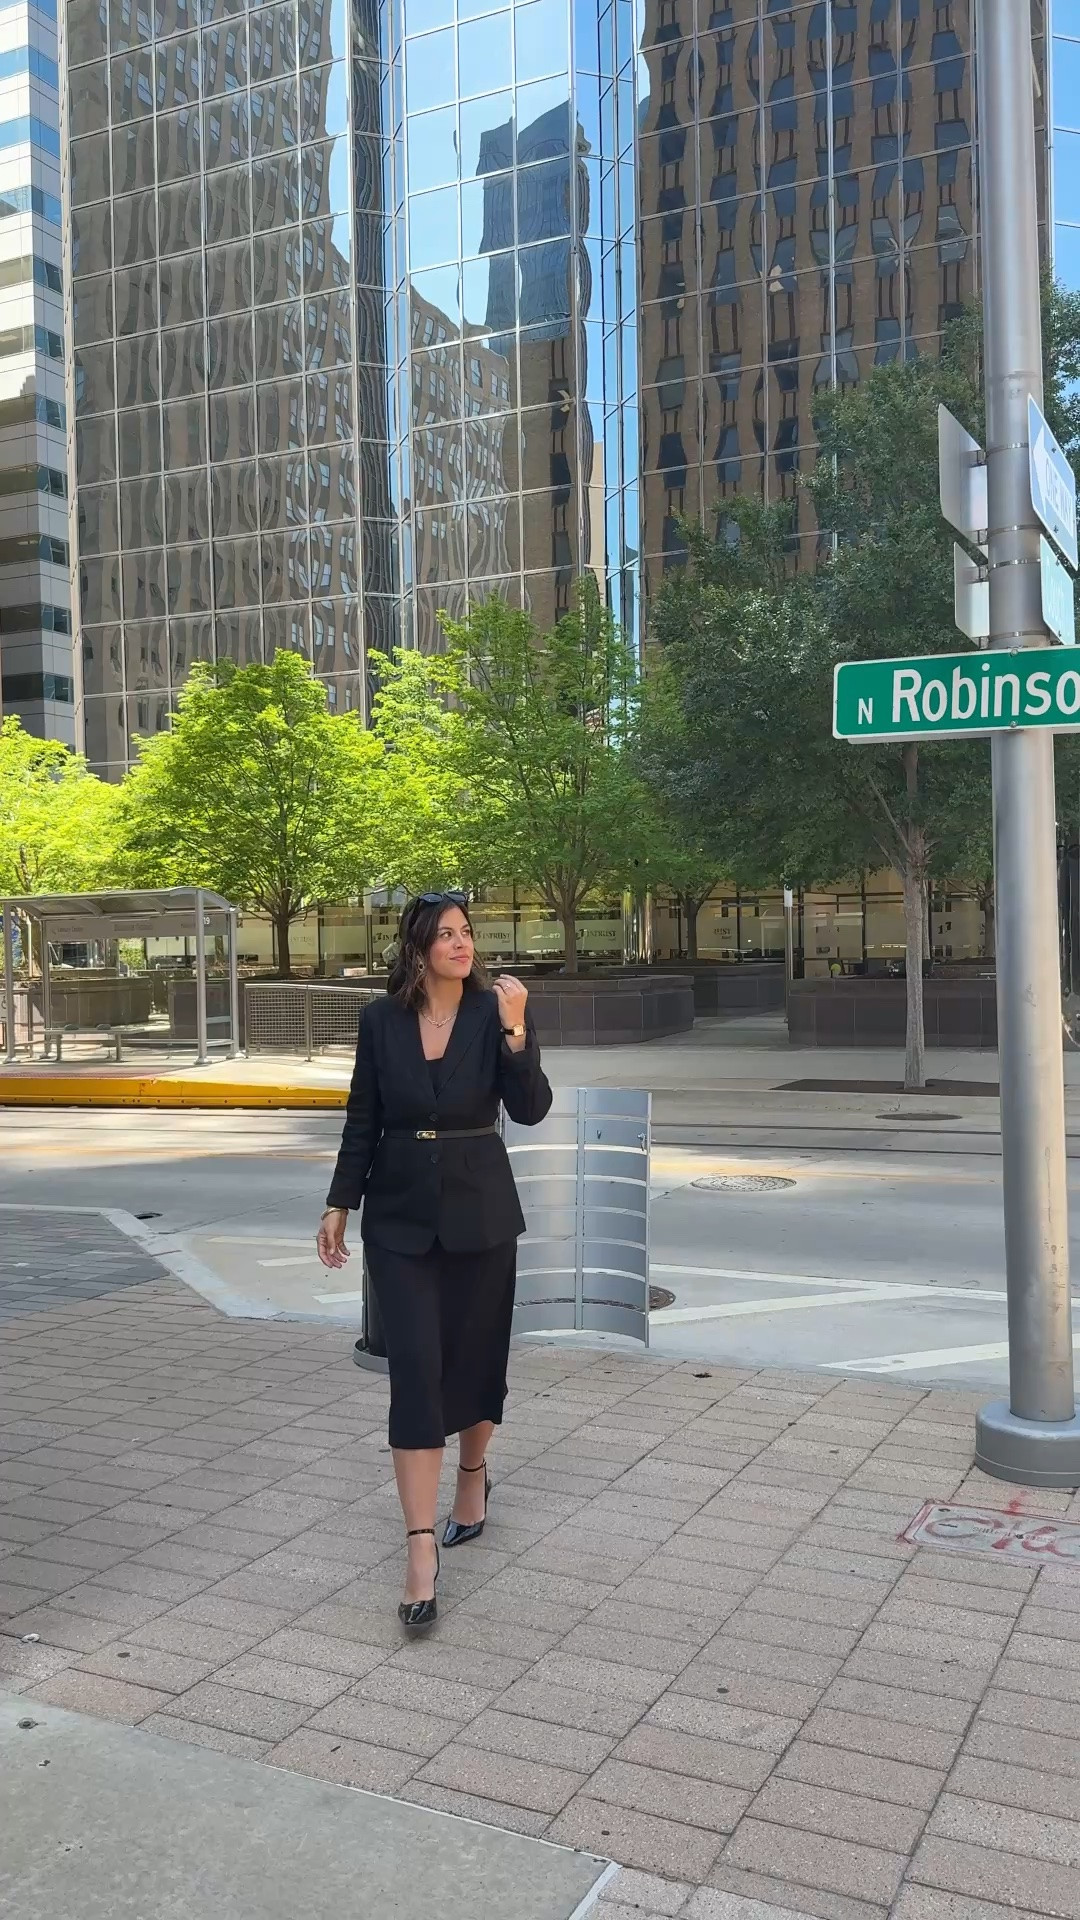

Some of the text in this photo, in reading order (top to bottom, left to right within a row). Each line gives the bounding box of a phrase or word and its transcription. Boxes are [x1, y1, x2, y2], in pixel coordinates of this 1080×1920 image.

[1045, 457, 1059, 512] ONE
[857, 662, 1080, 725] N Robinso
